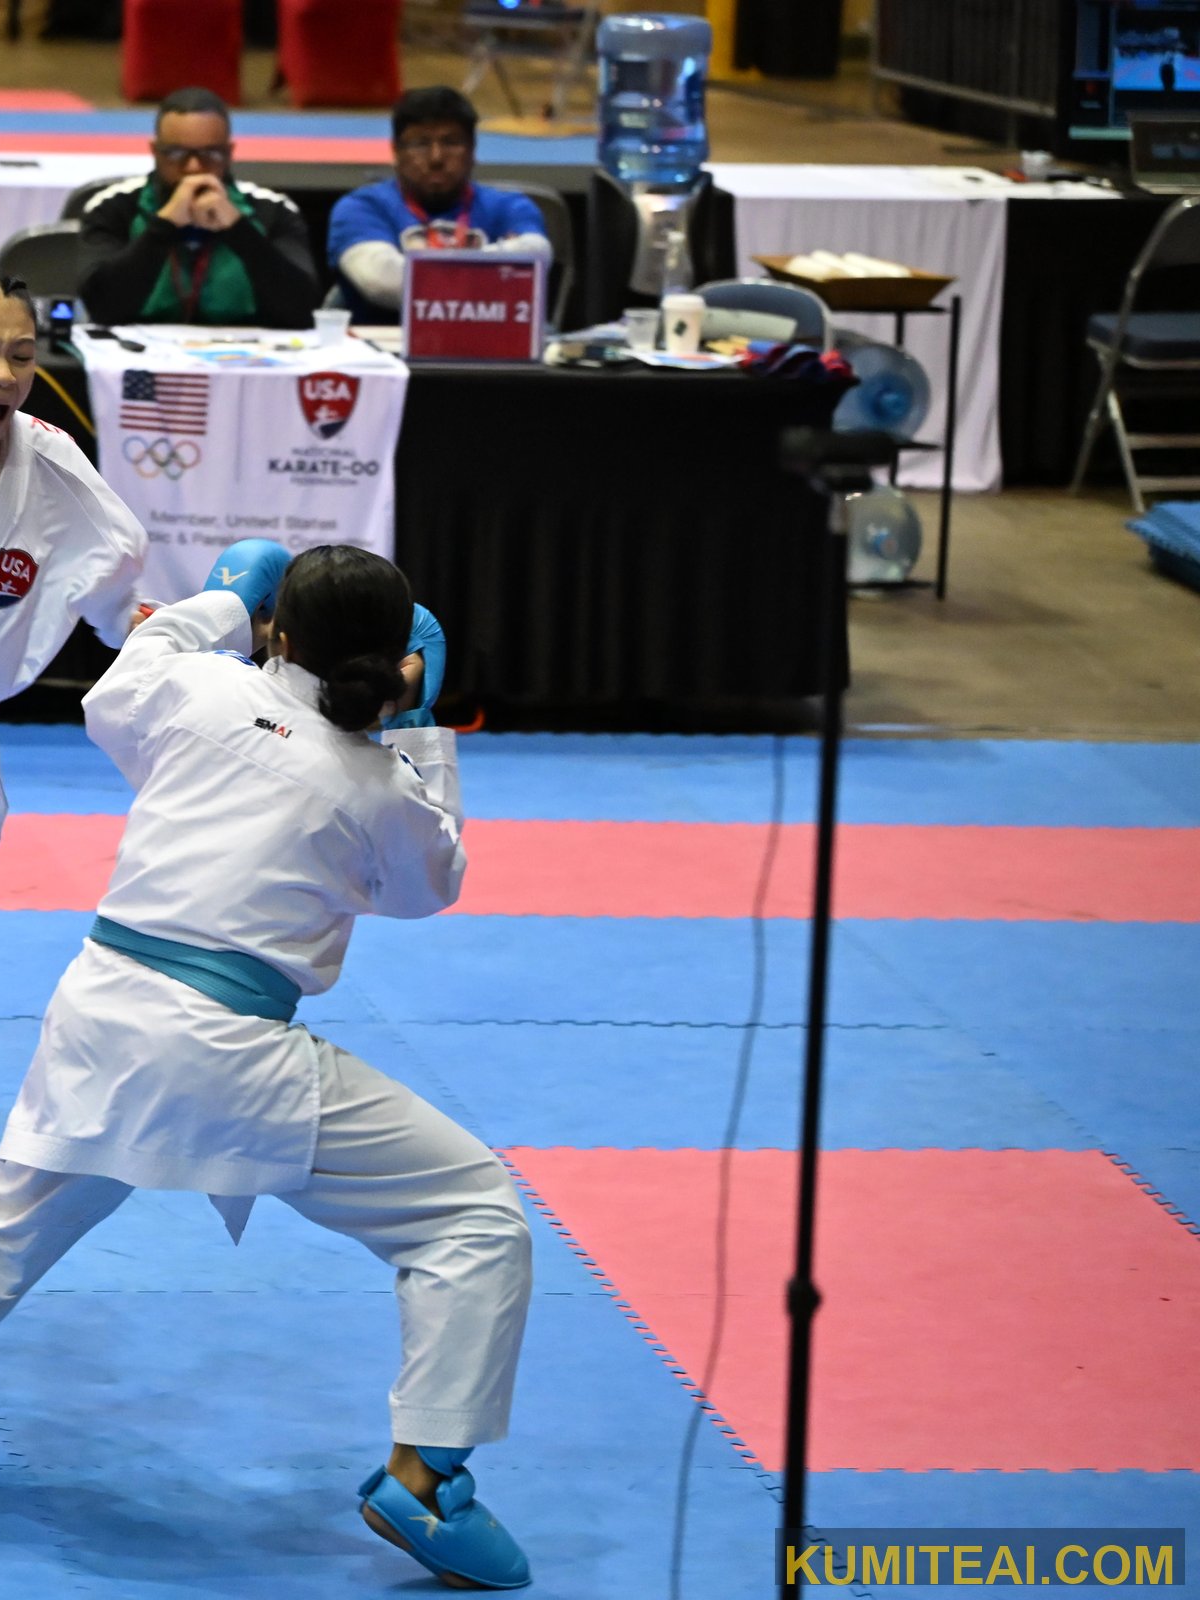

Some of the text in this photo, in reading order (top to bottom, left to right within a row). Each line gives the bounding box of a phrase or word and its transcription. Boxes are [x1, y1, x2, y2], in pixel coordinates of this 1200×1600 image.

[414, 301, 530, 323] TATAMI 2
[303, 379, 352, 401] USA
[268, 460, 380, 477] KARATE-DO
[1, 553, 31, 583] USA
[253, 717, 292, 739] SMAI
